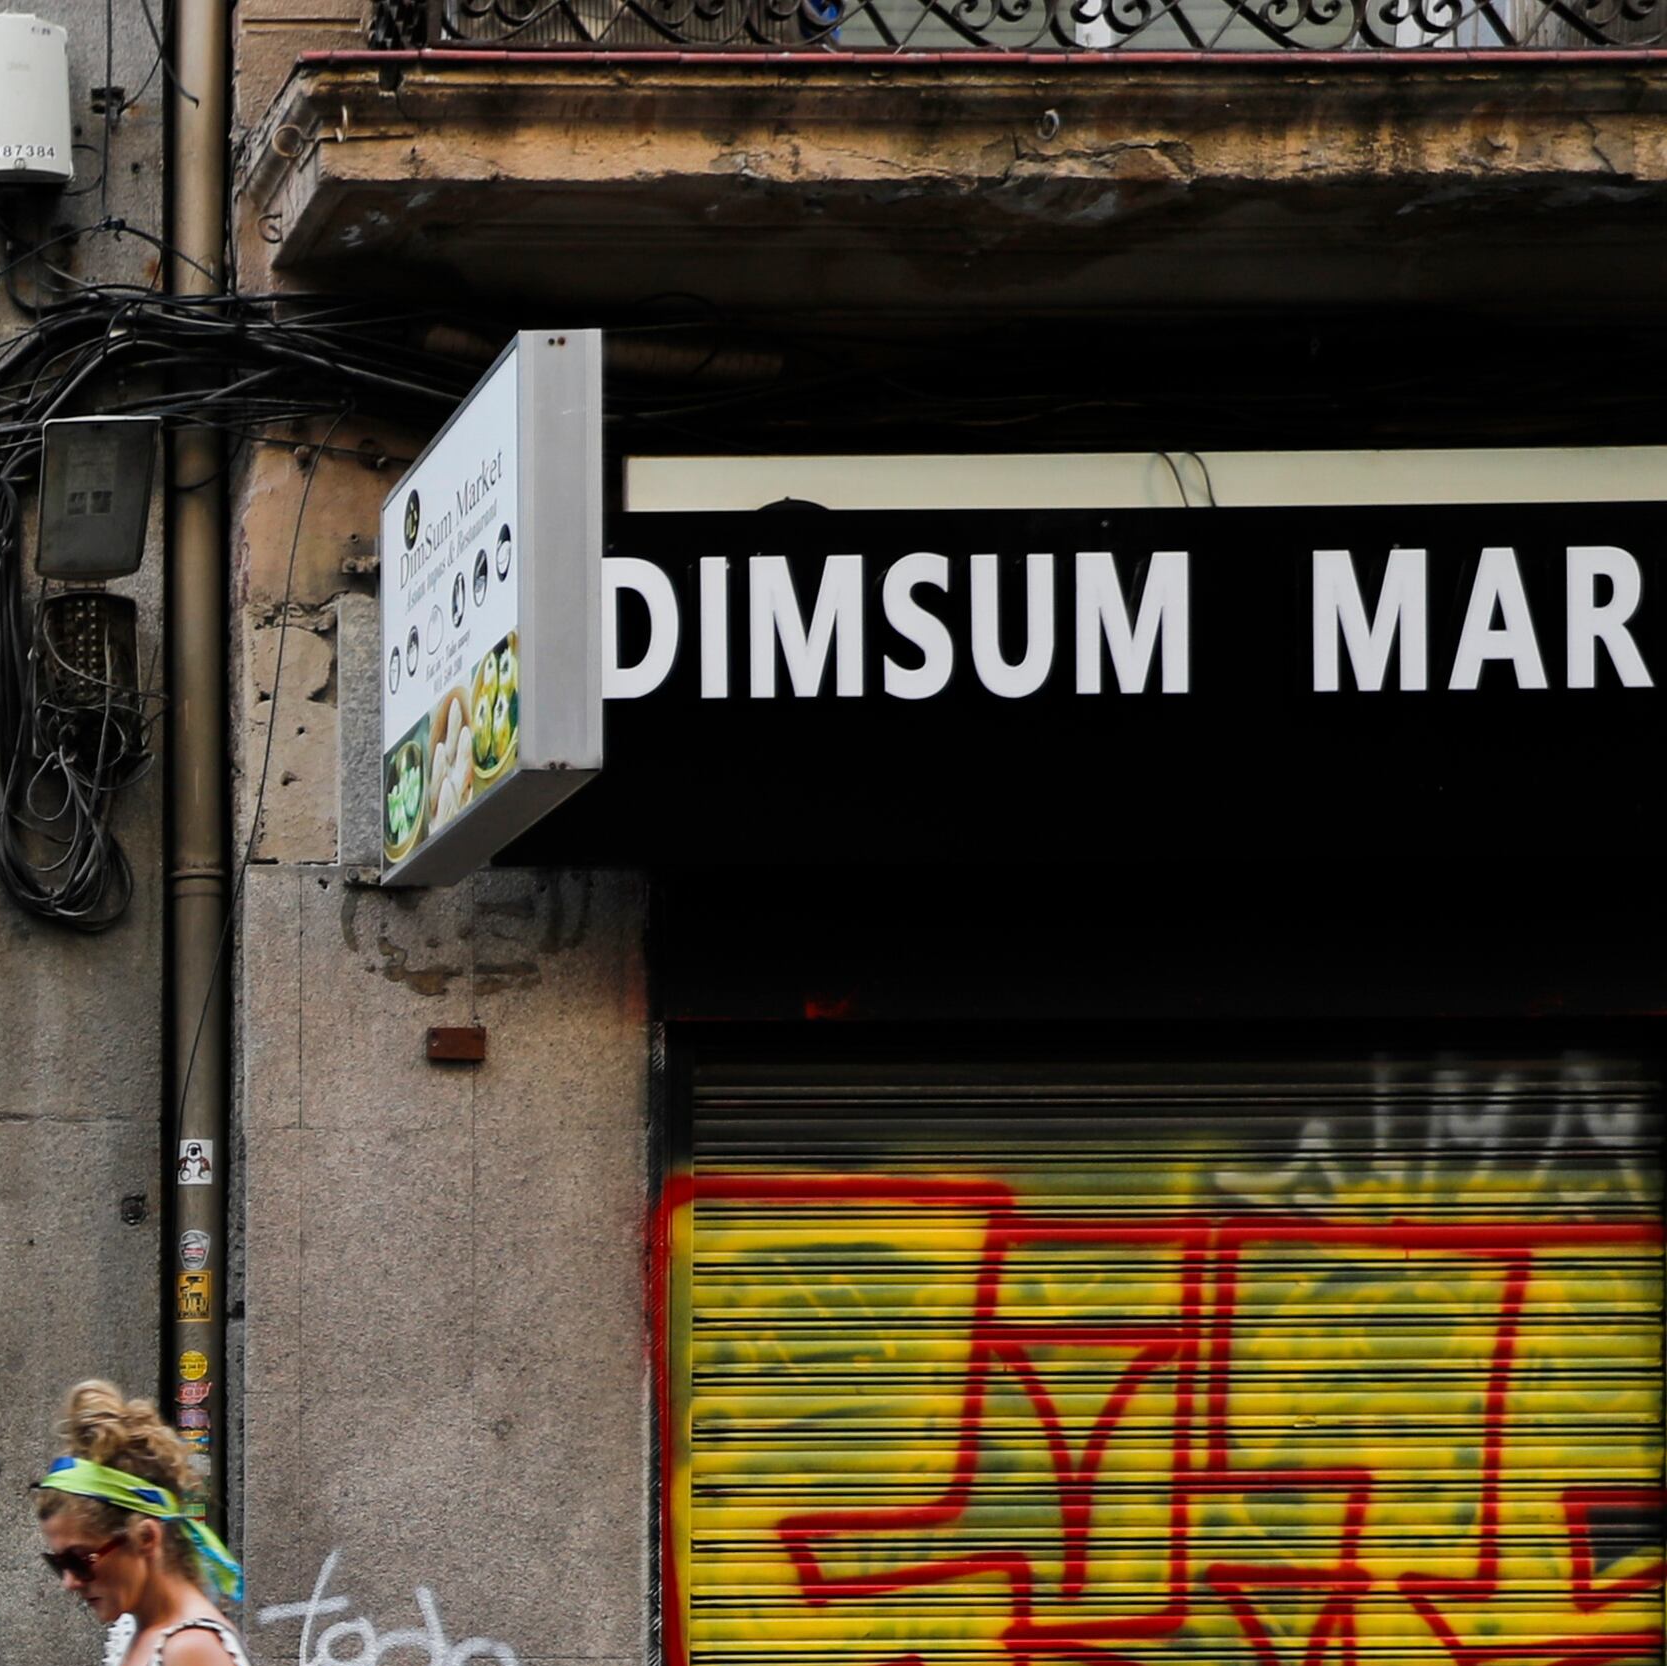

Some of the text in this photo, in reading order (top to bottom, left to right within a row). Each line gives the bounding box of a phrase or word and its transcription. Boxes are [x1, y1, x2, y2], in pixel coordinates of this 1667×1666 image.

[455, 449, 502, 526] Market
[601, 546, 1655, 699] DIMSUM MAR
